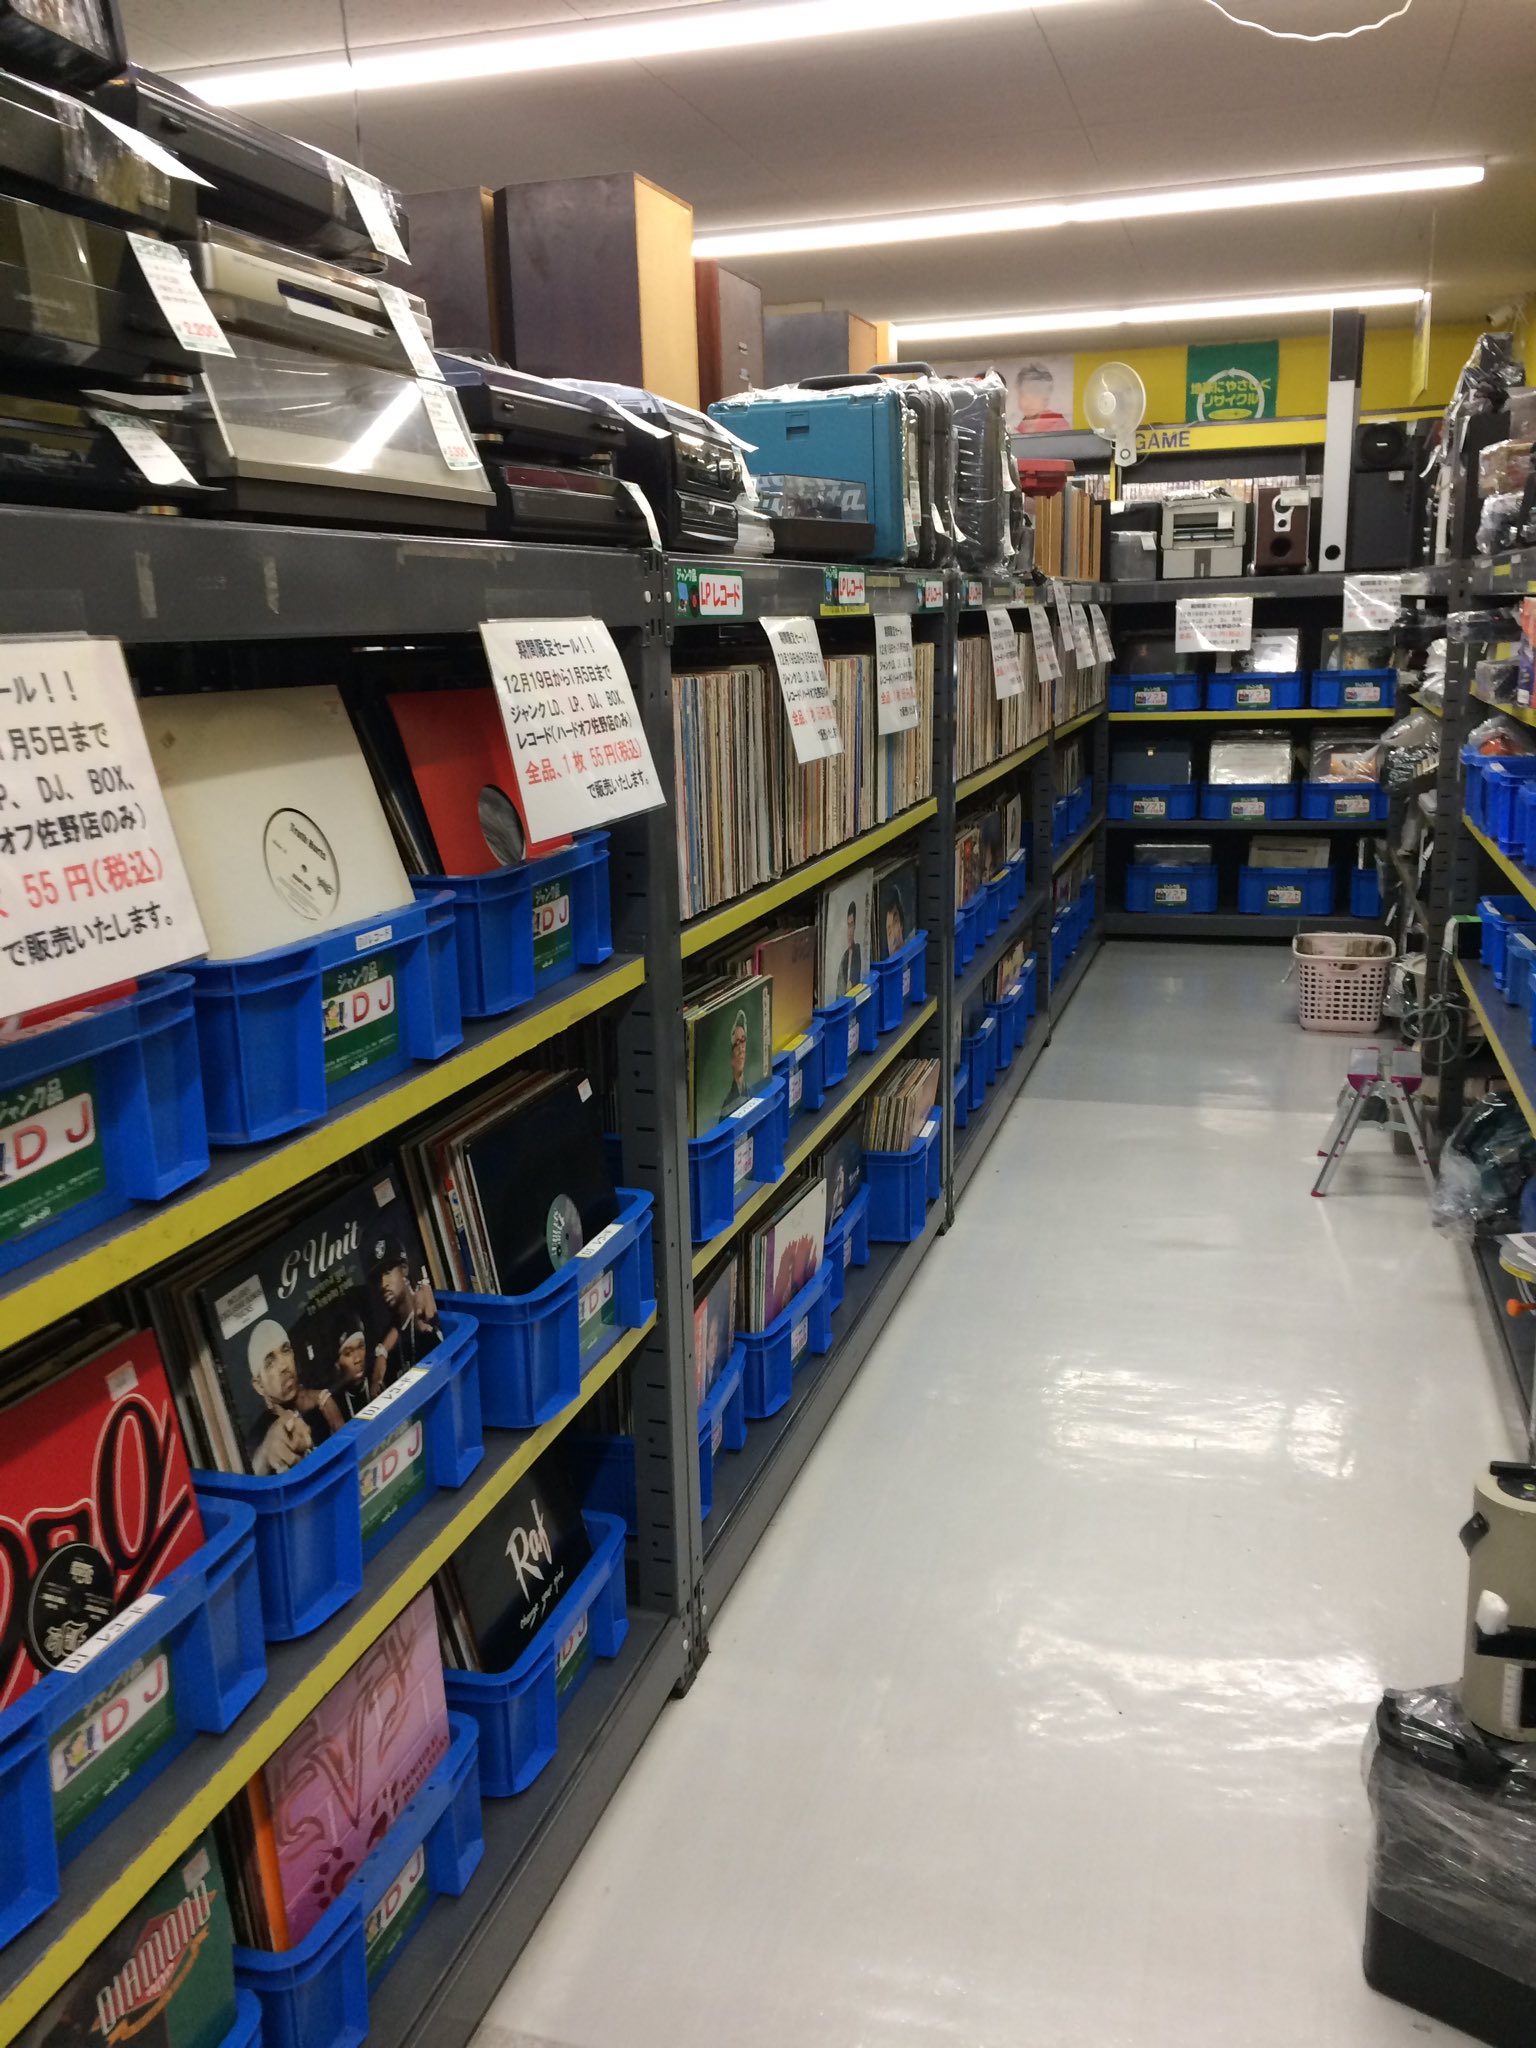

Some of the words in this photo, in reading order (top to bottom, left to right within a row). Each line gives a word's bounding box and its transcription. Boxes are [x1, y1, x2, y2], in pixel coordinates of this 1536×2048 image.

[1203, 393, 1260, 408] リサイクル
[1136, 430, 1190, 450] GAME
[6, 901, 175, 968] で販売いたします。
[302, 1220, 361, 1279] Unit
